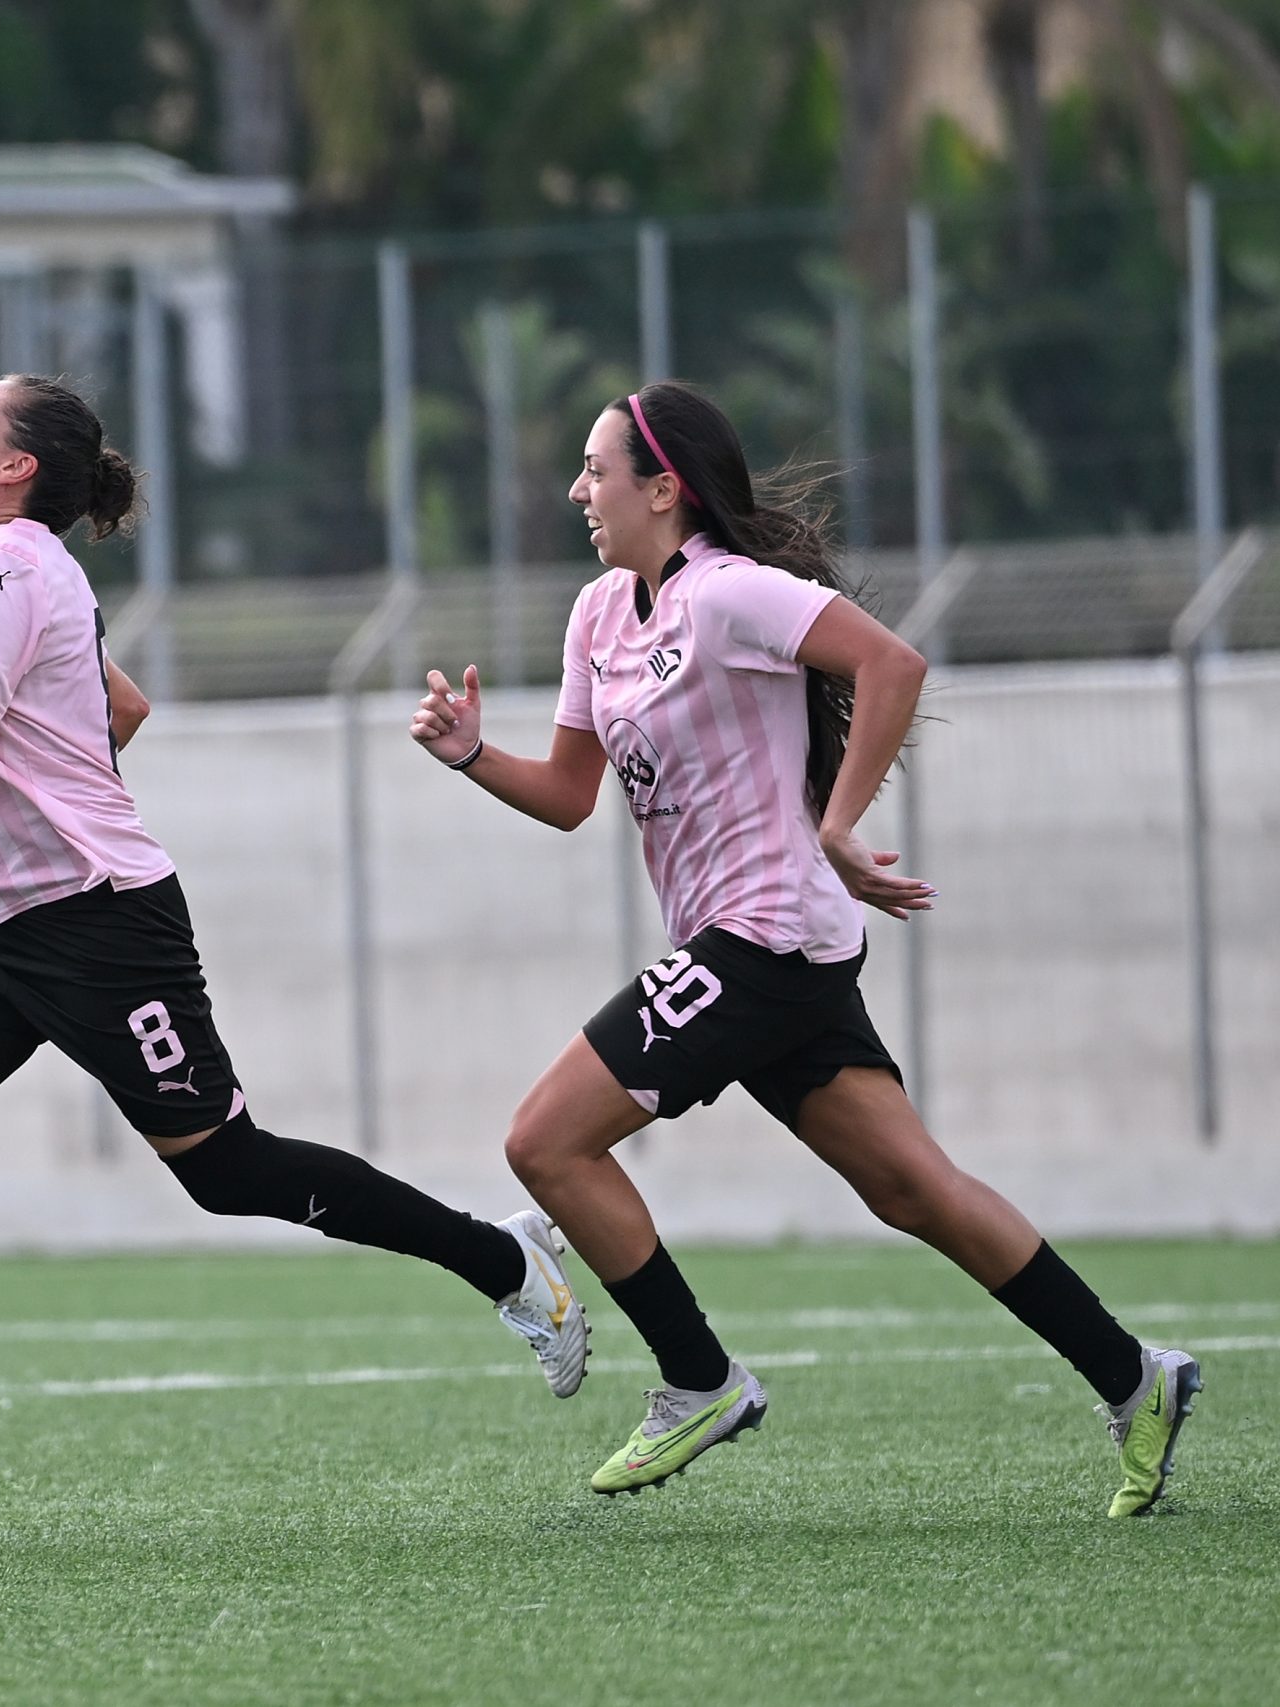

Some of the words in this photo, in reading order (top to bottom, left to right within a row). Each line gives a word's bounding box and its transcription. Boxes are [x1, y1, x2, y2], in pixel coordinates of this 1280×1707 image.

[617, 750, 656, 796] ecò
[640, 949, 723, 1029] 20
[127, 1000, 186, 1074] 8
